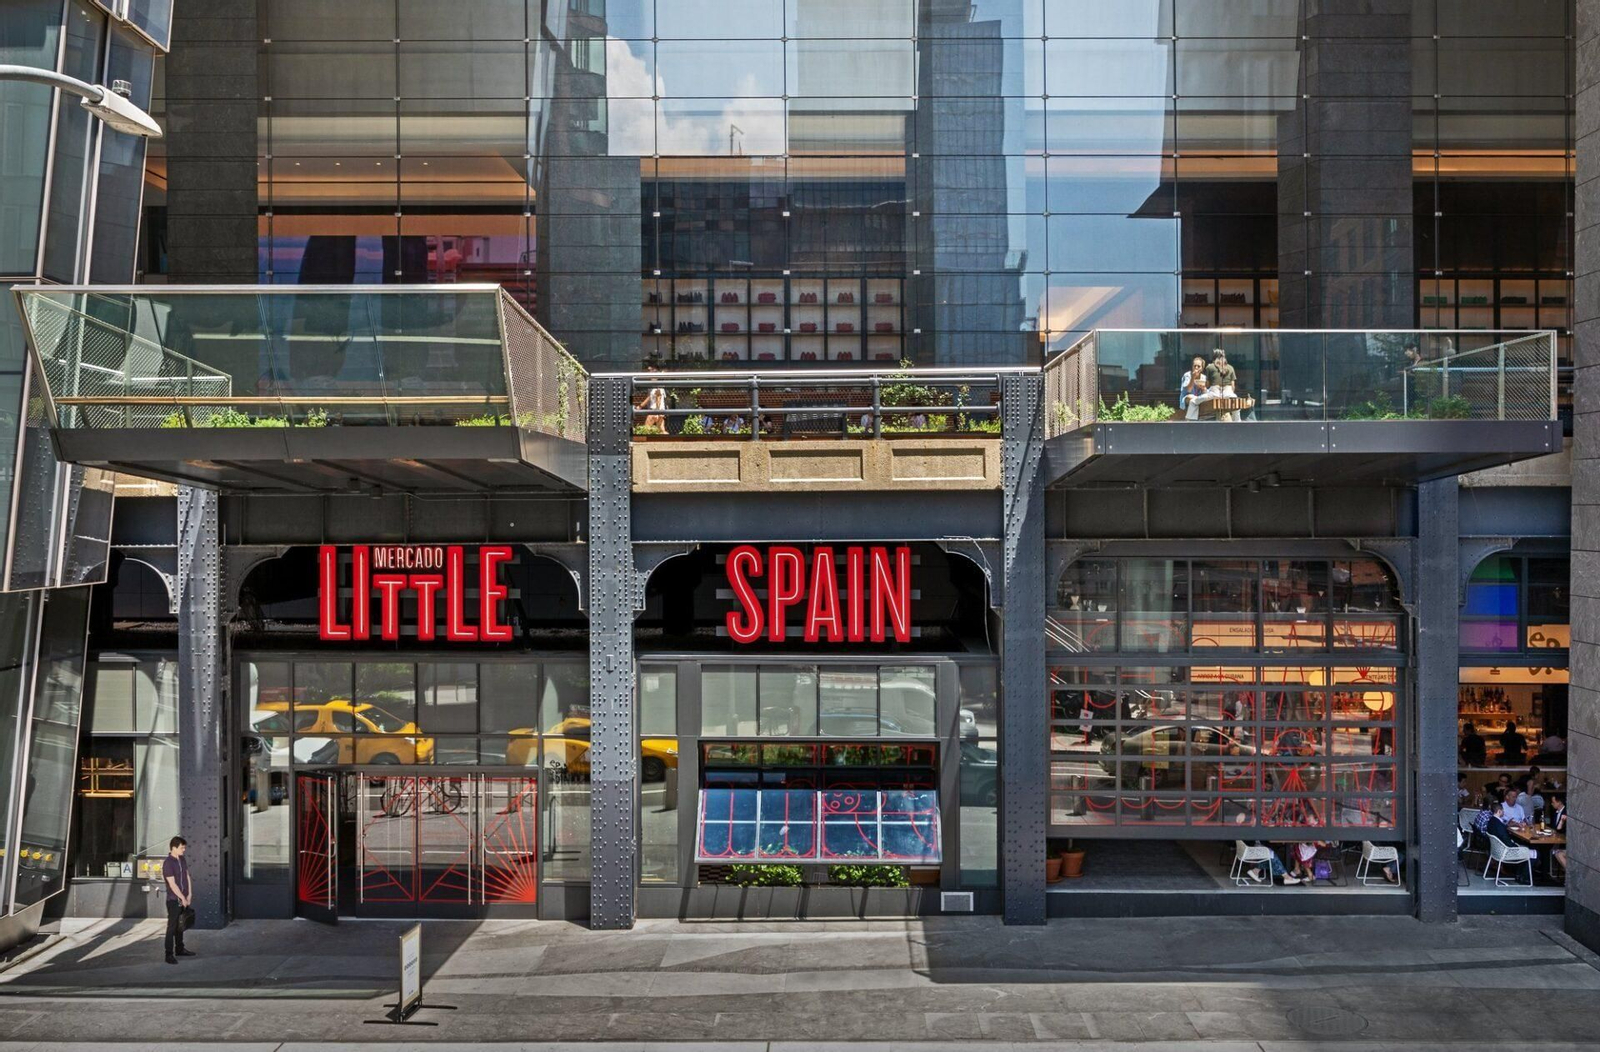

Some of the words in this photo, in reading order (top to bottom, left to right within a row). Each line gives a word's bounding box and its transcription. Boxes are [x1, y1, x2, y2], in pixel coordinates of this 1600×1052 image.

[374, 547, 443, 569] MERCADO
[319, 545, 513, 642] LITTLE
[726, 545, 910, 644] SPAIN
[123, 864, 131, 873] A
